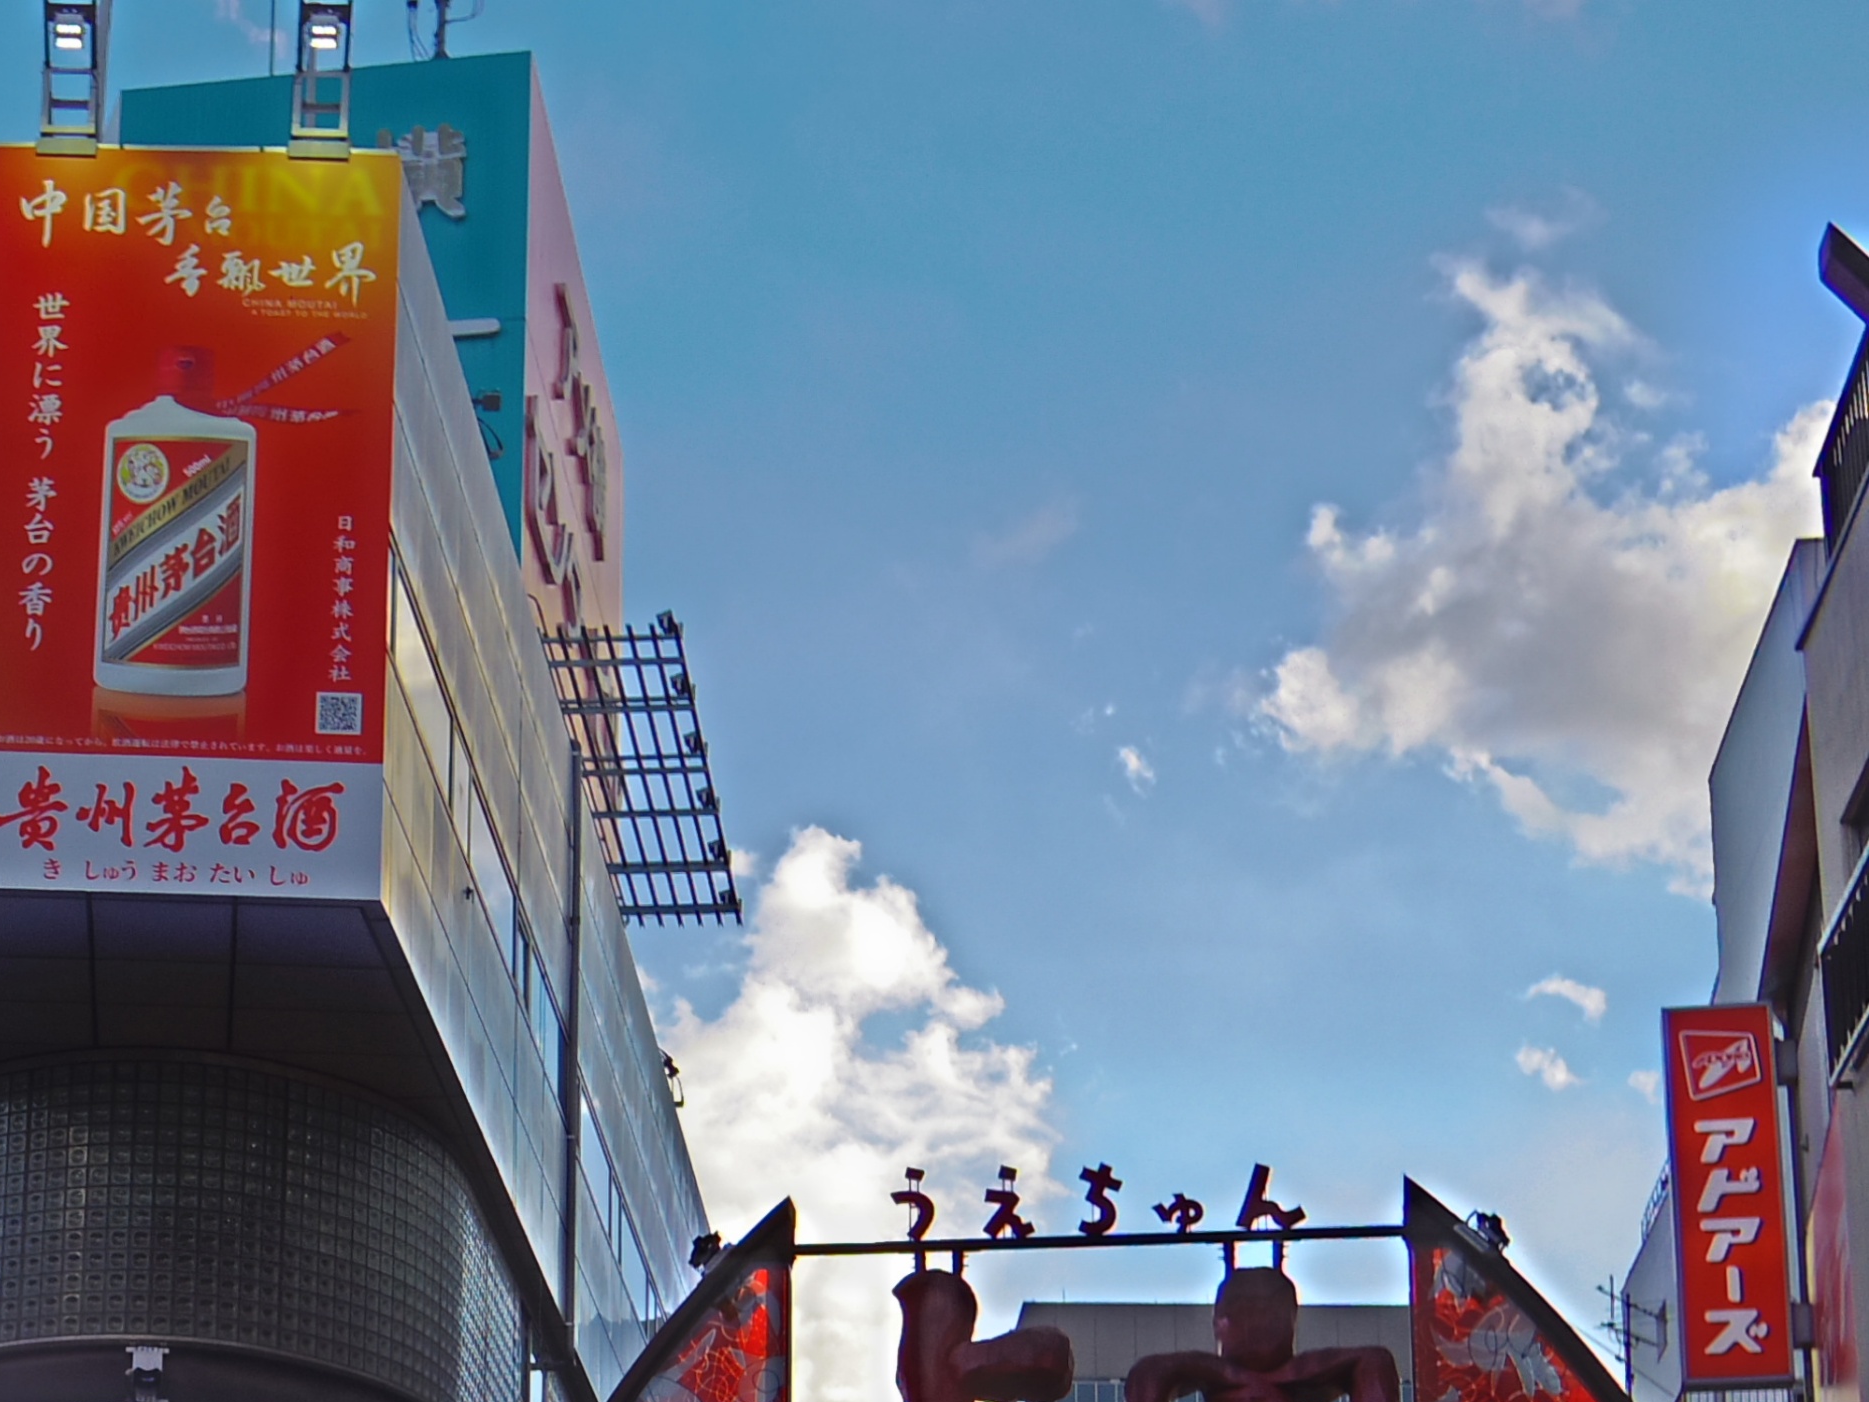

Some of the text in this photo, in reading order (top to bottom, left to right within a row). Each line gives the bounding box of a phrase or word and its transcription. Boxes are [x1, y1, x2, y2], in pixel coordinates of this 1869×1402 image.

[19, 180, 233, 248] 中国茅台
[18, 293, 70, 651] 世界に漂う 茅台の香り
[328, 514, 356, 682] 日和商事株式会社
[1694, 1118, 1769, 1355] アドアーズ
